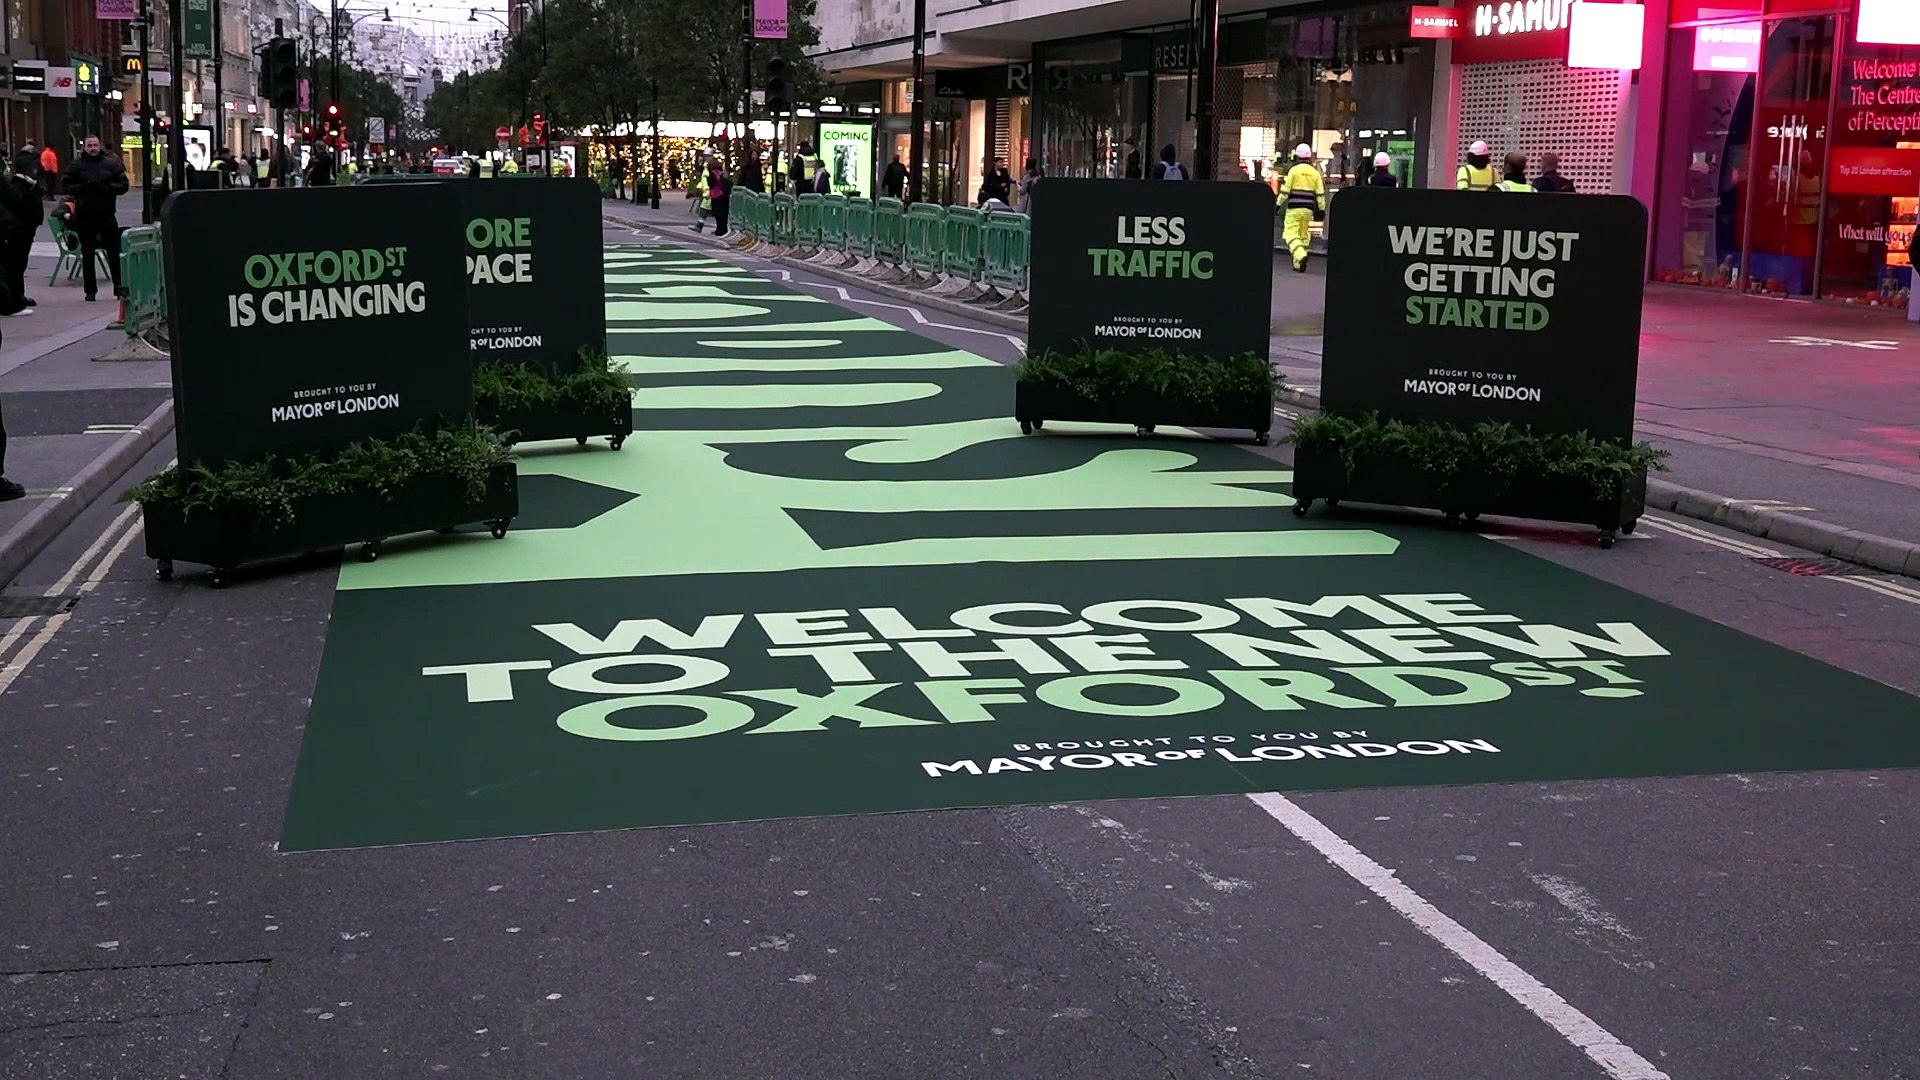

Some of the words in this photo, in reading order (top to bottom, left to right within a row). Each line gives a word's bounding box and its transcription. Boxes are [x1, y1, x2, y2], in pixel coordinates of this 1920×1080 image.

[1853, 59, 1917, 80] Welcome
[1851, 85, 1875, 105] The
[1848, 111, 1864, 131] of
[823, 131, 869, 142] COMING
[1840, 165, 1850, 176] Top
[1860, 167, 1881, 175] London
[1882, 167, 1912, 176] attraction
[466, 217, 532, 249] ORE
[1117, 215, 1186, 246] LESS
[1387, 225, 1495, 258] WE'RE
[1500, 229, 1580, 266] JUST
[1838, 223, 1864, 240] What
[1865, 226, 1883, 241] will
[244, 248, 384, 288] OXFORD
[1087, 248, 1214, 280] TRAFFIC
[1404, 262, 1556, 298] GETTING
[228, 293, 256, 327] IS
[261, 281, 426, 325] CHANGING
[1405, 295, 1550, 331] STARTED
[477, 338, 488, 346] OF
[488, 335, 542, 349] LONDON
[1094, 325, 1136, 337] MAYOR
[1148, 327, 1201, 340] LONDON
[1428, 368, 1468, 378] BROUGHT
[1471, 371, 1483, 379] TO
[1486, 372, 1504, 380] YOU
[1506, 373, 1518, 381] BY
[293, 387, 332, 399] BROUGHT
[335, 385, 346, 394] TO
[348, 383, 365, 393] YOU
[366, 382, 377, 391] BY
[1404, 378, 1457, 395] MAYOR
[1457, 382, 1471, 392] OF
[1471, 383, 1541, 402] LONDON
[271, 402, 323, 423] MAYOR
[323, 400, 336, 411] OF
[337, 393, 400, 415] LONDON
[531, 592, 1524, 655] WELCOME
[422, 654, 731, 703] TO
[765, 633, 1190, 684] THE
[1190, 621, 1671, 667] NEW
[556, 665, 1513, 742] OXFORD
[1012, 736, 1173, 752] BROUGHT
[1188, 734, 1237, 745] TO
[1250, 731, 1320, 743] YOU
[1331, 729, 1375, 740] BY
[921, 750, 1160, 778] MAYOR
[1155, 748, 1206, 762] OF
[1217, 738, 1502, 765] LONDON
